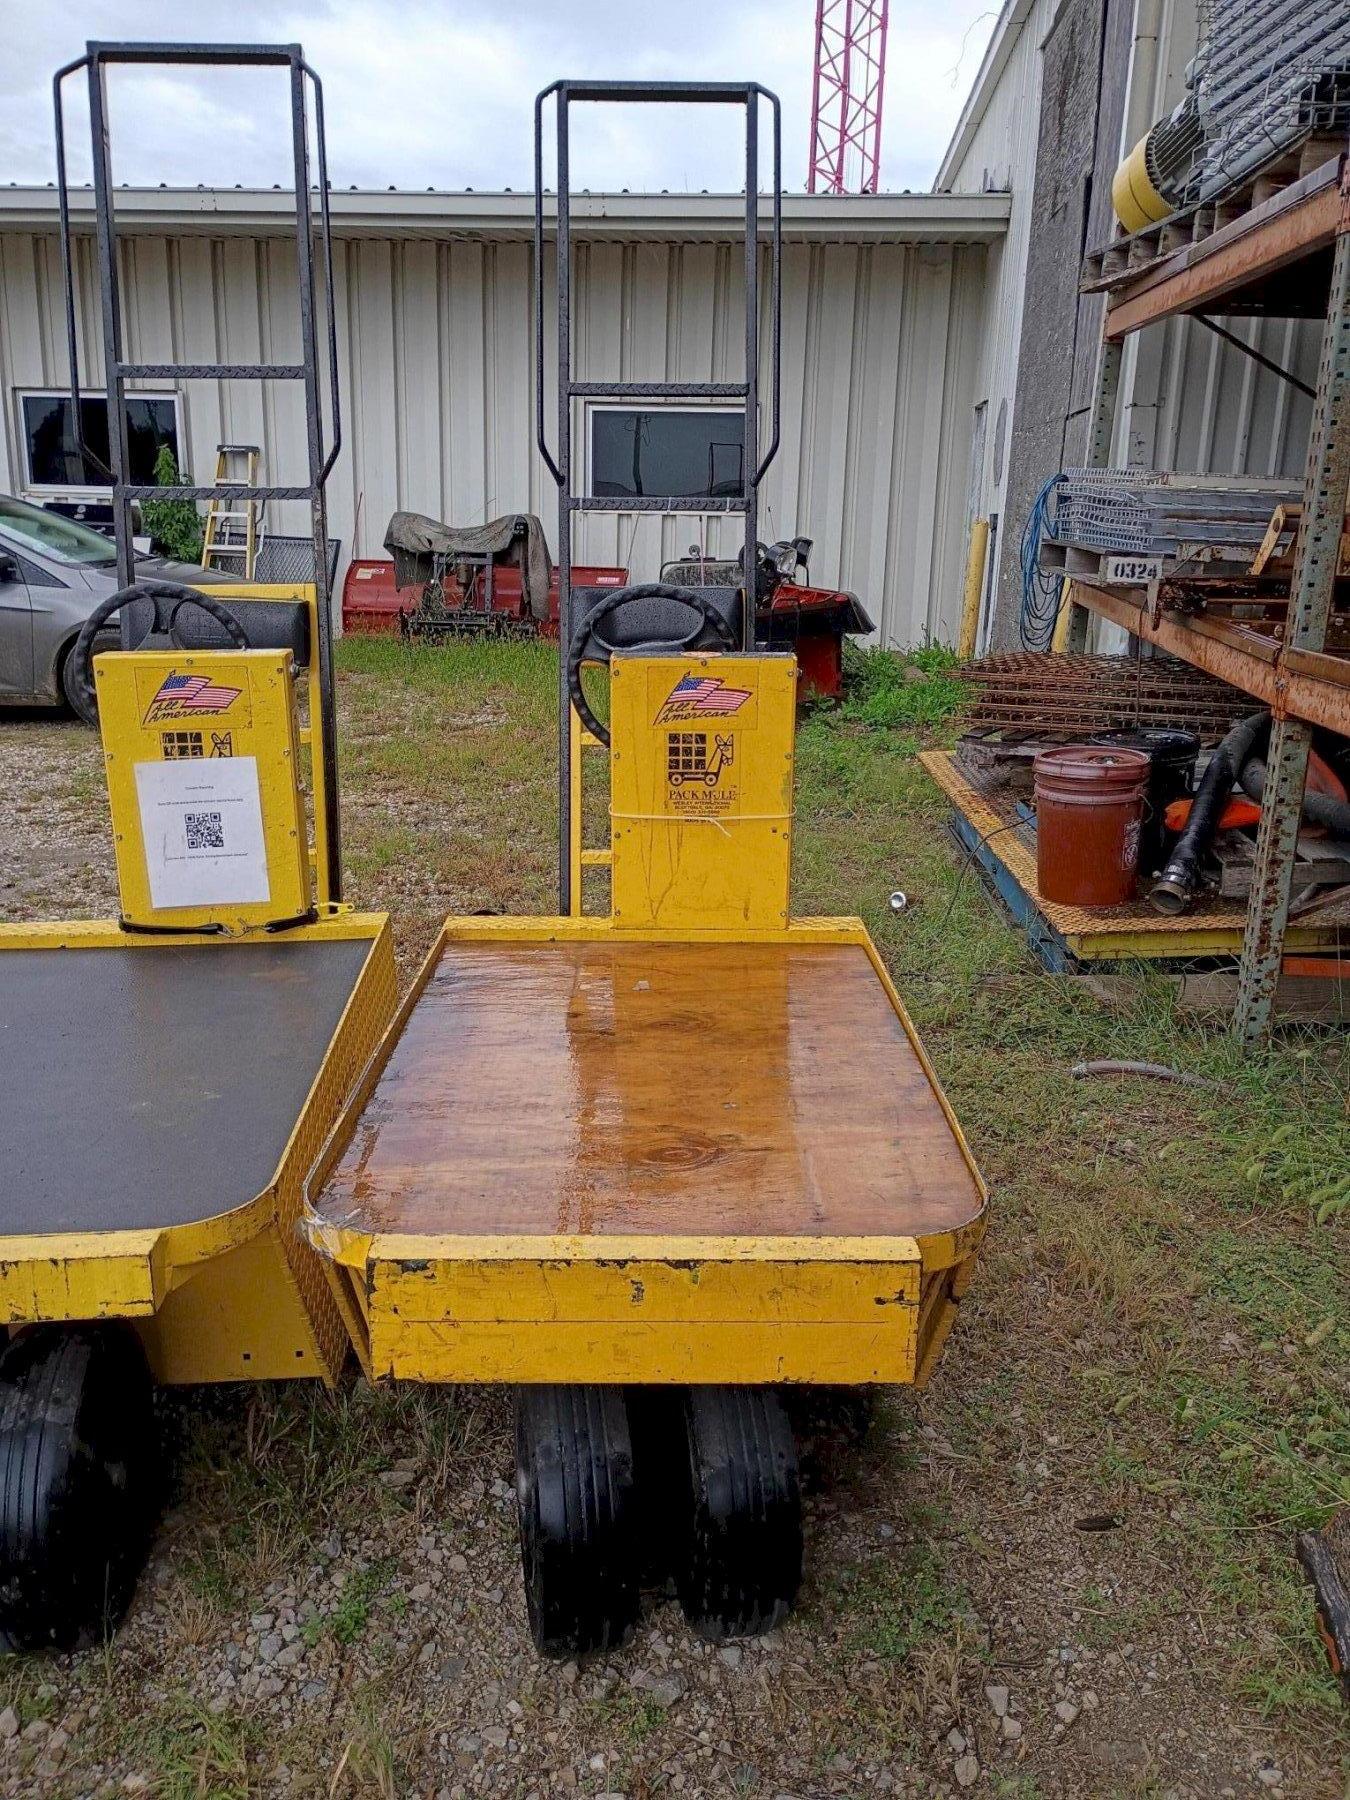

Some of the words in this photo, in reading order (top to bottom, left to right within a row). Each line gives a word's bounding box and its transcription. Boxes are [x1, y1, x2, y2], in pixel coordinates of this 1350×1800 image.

[1114, 563, 1157, 579] 0324
[152, 701, 180, 713] All
[663, 702, 691, 714] All
[148, 708, 230, 722] American
[658, 709, 739, 724] American
[669, 790, 698, 800] PACK
[702, 790, 736, 800] MULE
